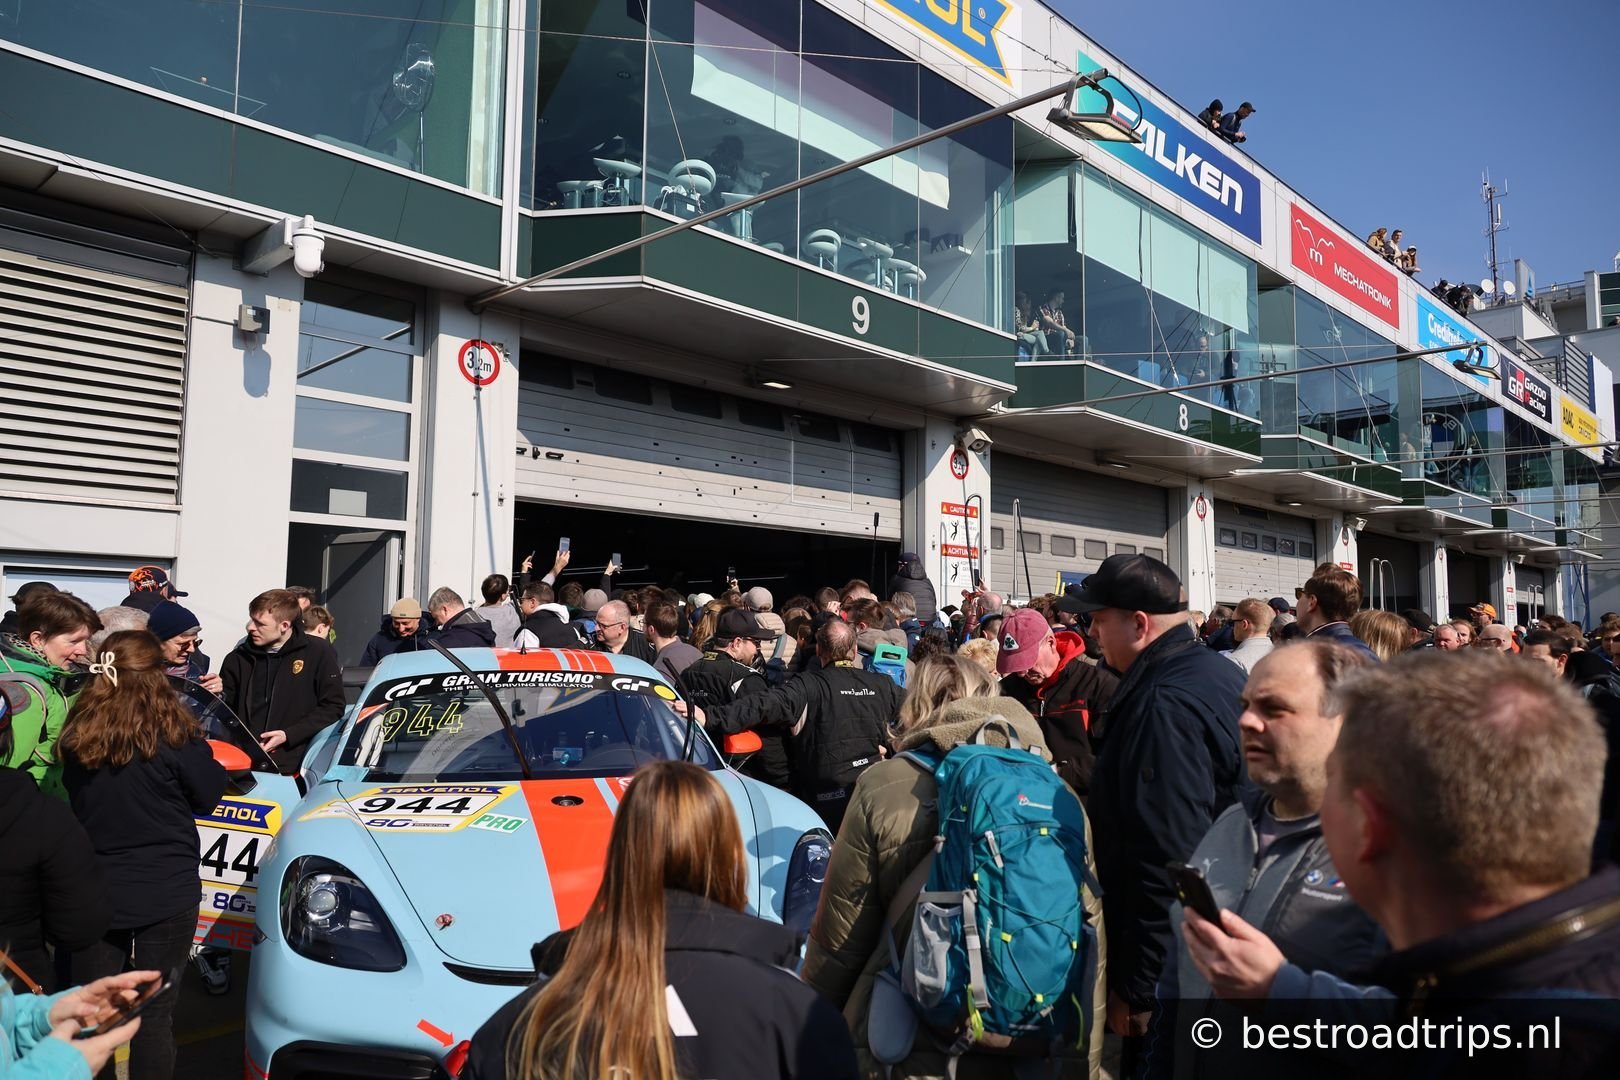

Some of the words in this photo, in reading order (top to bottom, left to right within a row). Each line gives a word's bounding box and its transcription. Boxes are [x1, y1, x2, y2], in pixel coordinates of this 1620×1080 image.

[1334, 262, 1392, 310] MECHATRONIK
[852, 295, 870, 335] 9
[1508, 376, 1524, 401] GR
[1525, 377, 1546, 401] GAZOO
[1524, 391, 1546, 417] Racing
[1179, 403, 1189, 431] 8
[380, 701, 464, 743] 944
[386, 786, 493, 795] RAVENOL
[211, 804, 261, 822] ENOL
[357, 796, 473, 814] 944
[472, 814, 523, 831] PRO
[200, 833, 260, 882] 44
